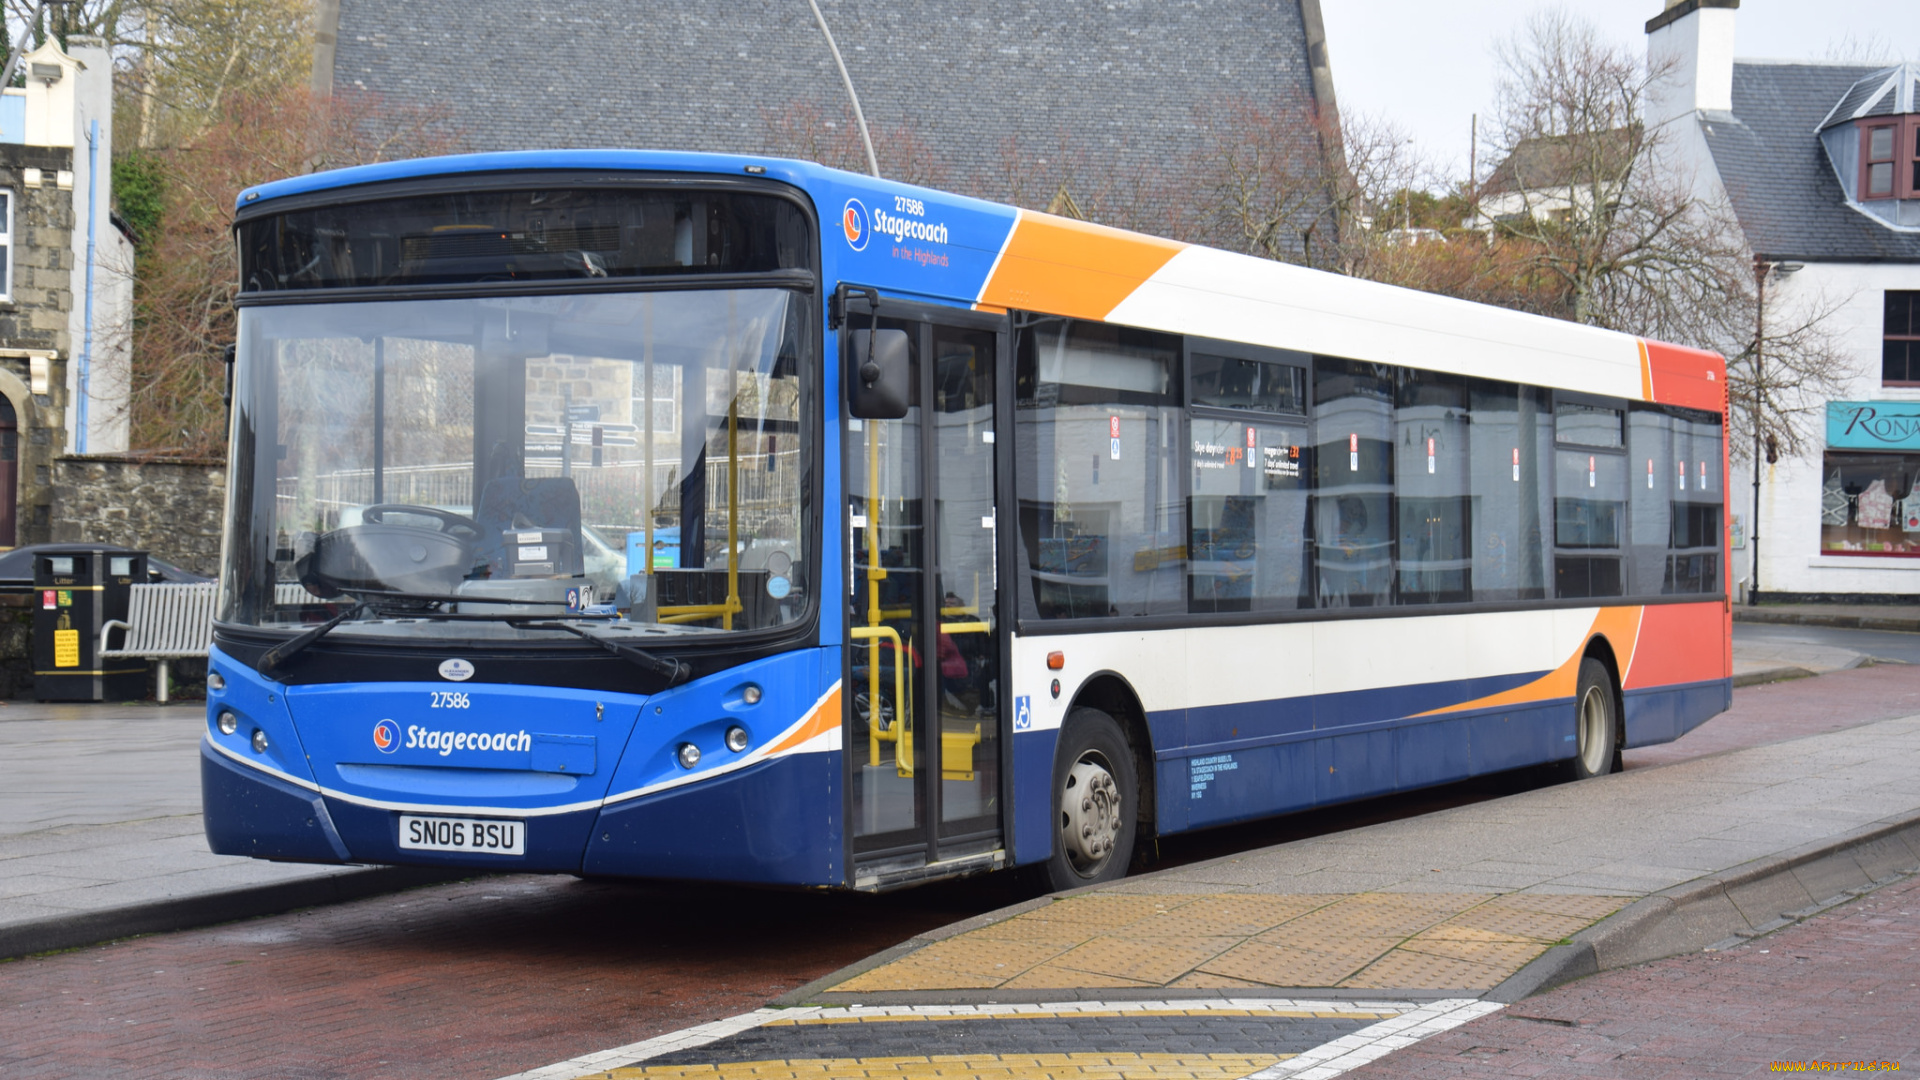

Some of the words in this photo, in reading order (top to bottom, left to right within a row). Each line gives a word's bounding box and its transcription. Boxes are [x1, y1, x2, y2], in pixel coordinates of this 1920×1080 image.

[894, 195, 925, 217] 27586
[874, 208, 948, 244] Stagecoach
[892, 245, 899, 258] in
[901, 245, 912, 260] the
[914, 247, 949, 267] Highlands
[1194, 441, 1205, 455] Skye
[54, 577, 74, 585] Litter
[431, 692, 470, 709] 27586
[405, 724, 531, 756] Stagecoach
[409, 820, 465, 846] SN06
[472, 823, 514, 849] BSU
